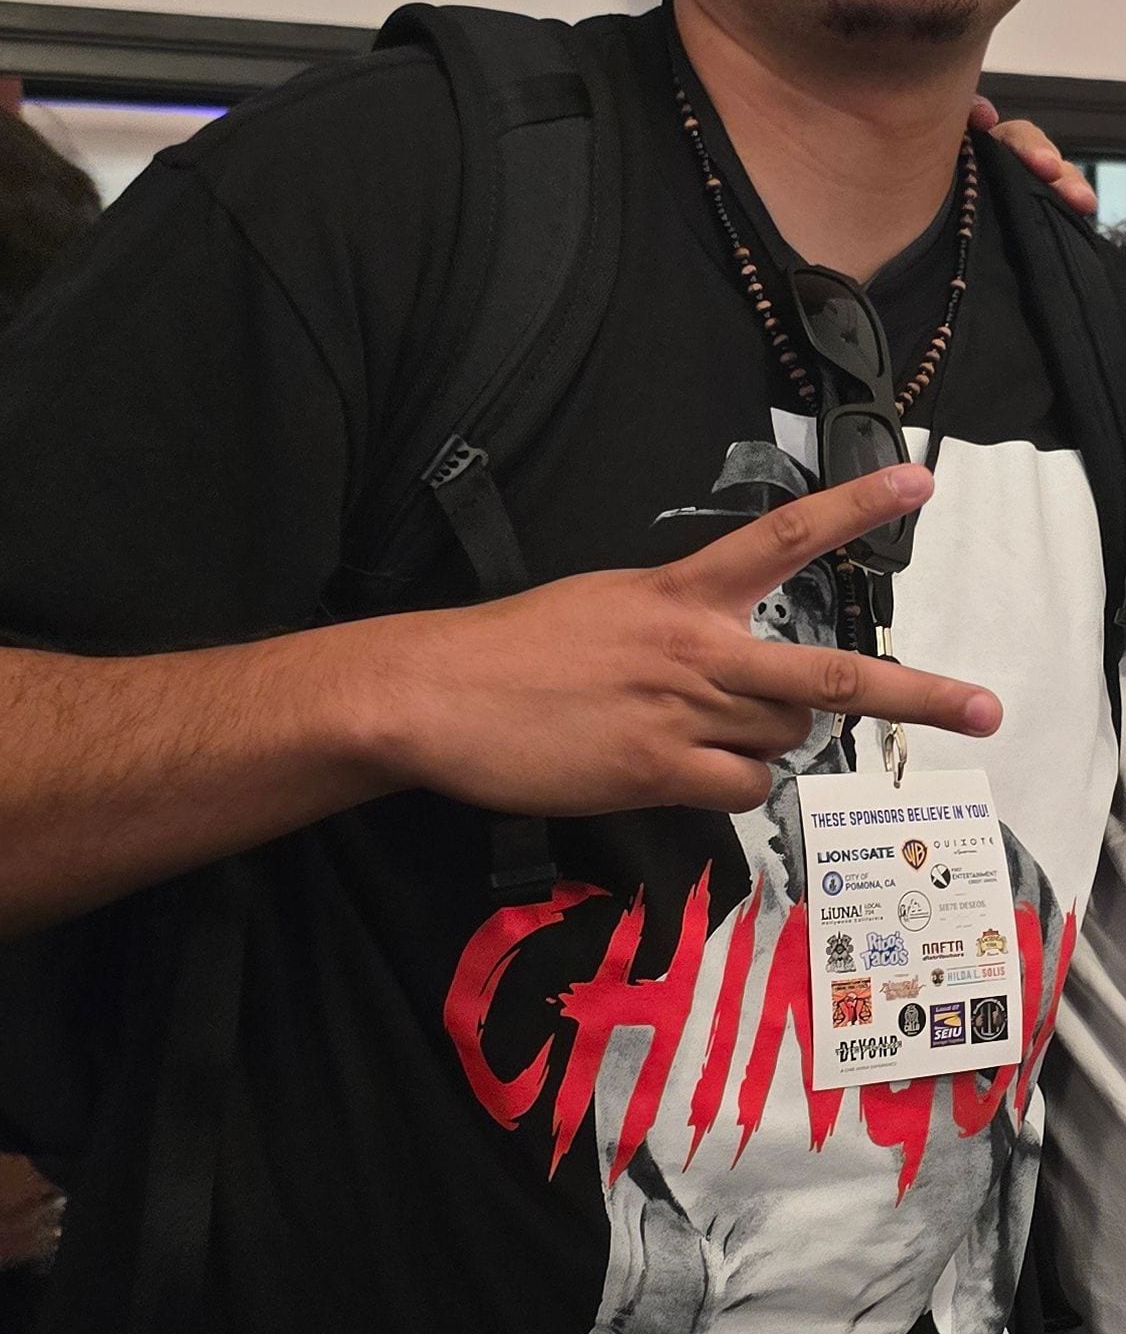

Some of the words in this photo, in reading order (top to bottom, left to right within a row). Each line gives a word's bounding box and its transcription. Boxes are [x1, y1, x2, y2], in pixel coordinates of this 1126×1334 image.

[811, 812, 847, 828] THESE
[849, 808, 905, 826] SPONSORS
[907, 805, 951, 822] BELIEVE
[952, 805, 964, 819] IN
[965, 803, 990, 818] YOU!
[817, 846, 895, 864] LIONSGATE
[845, 873, 859, 882] CITY
[845, 879, 883, 892] POMONA,
[884, 879, 896, 888] CA
[922, 939, 964, 956] NAFTA
[947, 969, 973, 982] HILDA
[982, 967, 1006, 979] SOLIS
[934, 1027, 963, 1040] SEIU
